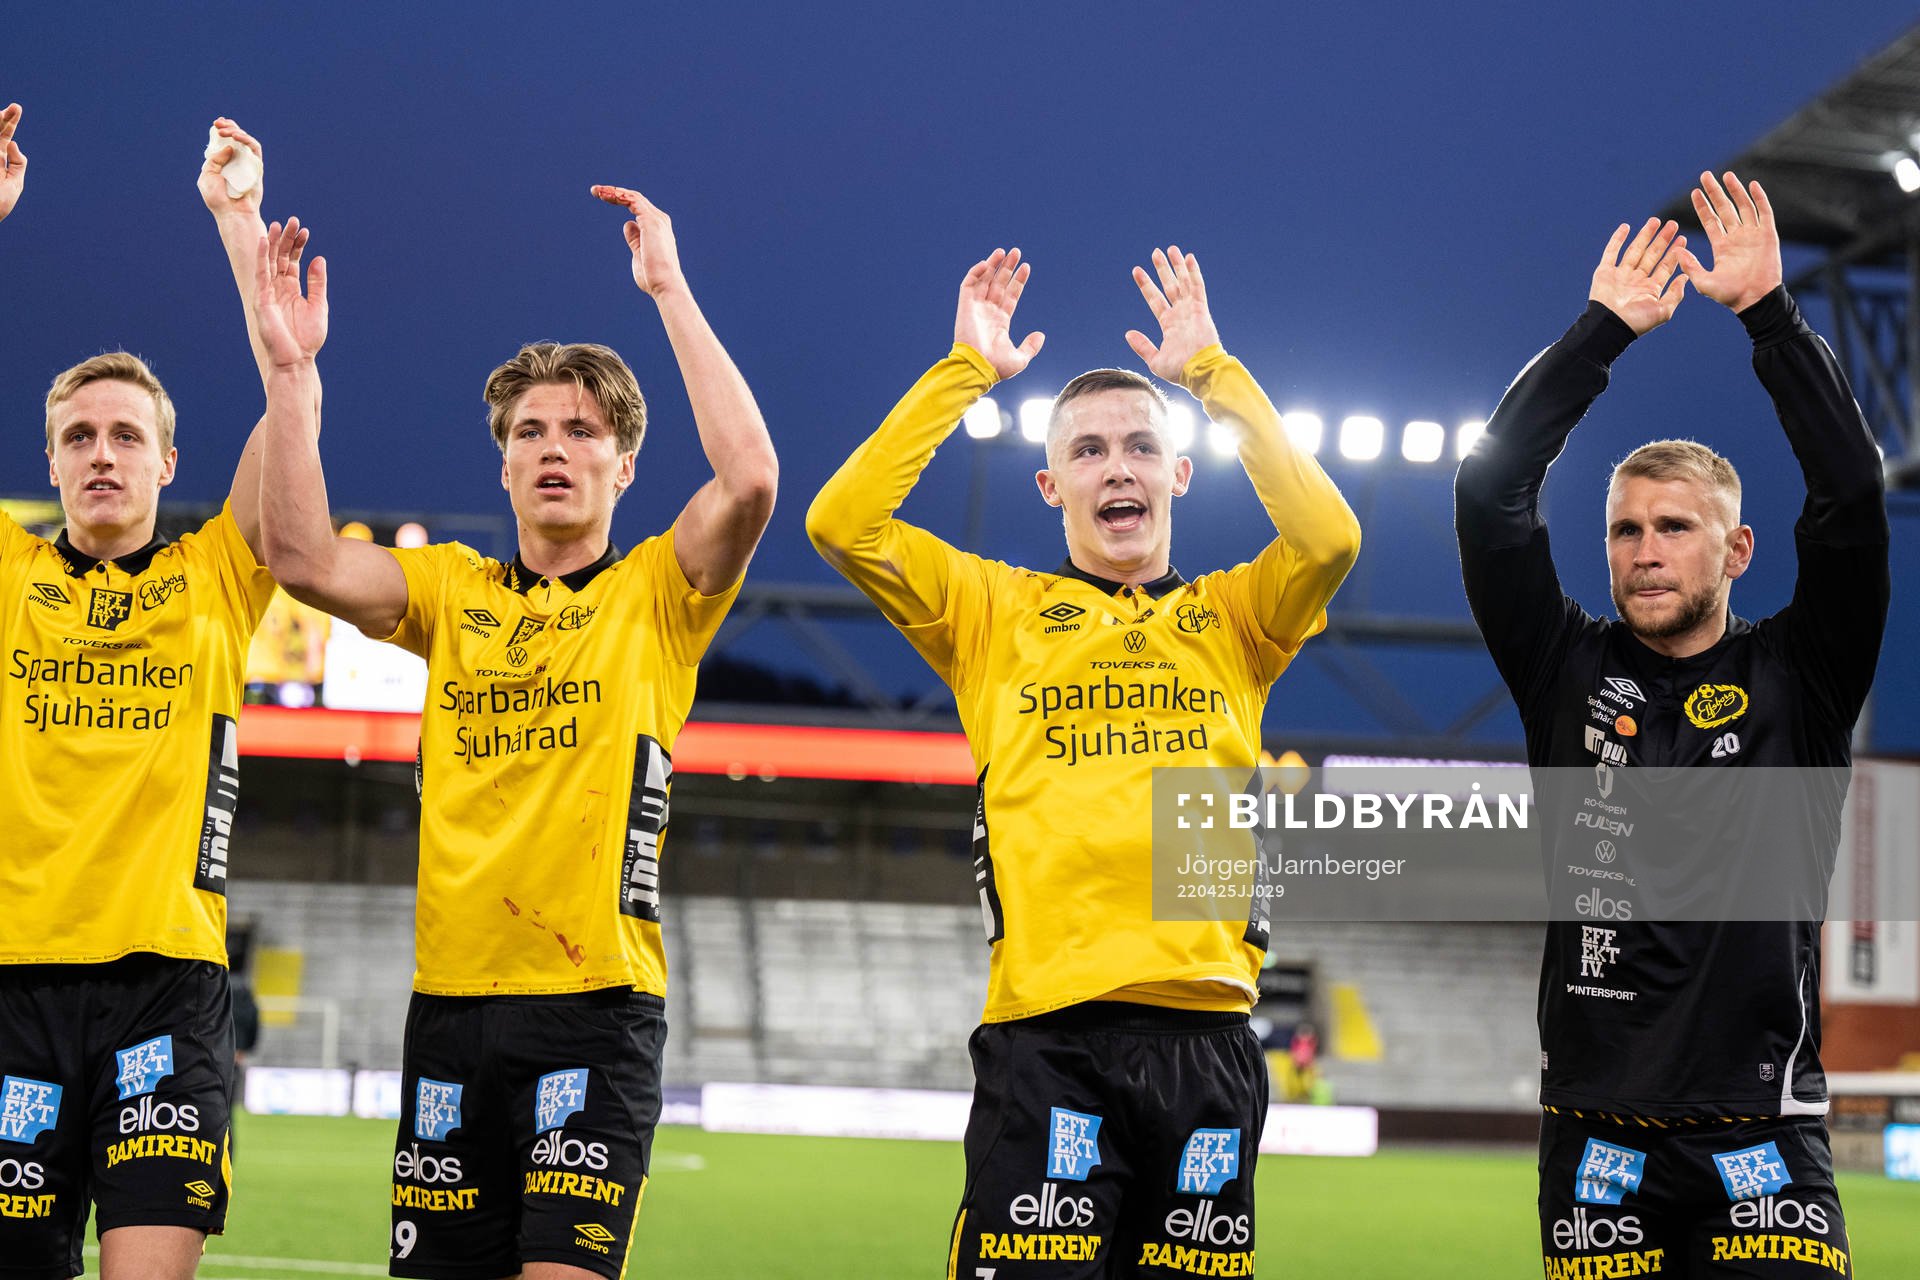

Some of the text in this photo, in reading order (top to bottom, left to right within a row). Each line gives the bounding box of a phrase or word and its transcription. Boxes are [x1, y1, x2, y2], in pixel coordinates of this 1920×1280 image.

[28, 593, 60, 612] umbro
[94, 590, 126, 606] EFF
[139, 574, 187, 611] Elfsborg
[92, 601, 129, 619] EKT
[460, 621, 490, 639] umbro
[1044, 622, 1080, 634] umbro
[63, 637, 123, 649] TOVEKS
[9, 648, 194, 690] Sparbanken
[475, 669, 532, 679] TOVEKS
[1089, 661, 1178, 670] TOVEKS BIL
[439, 676, 602, 720] Sparbanken
[1019, 674, 1228, 719] Sparbanken
[1600, 687, 1634, 710] umbro
[24, 693, 173, 733] Sjuhärad
[454, 716, 578, 765] Sjuhärad
[1045, 721, 1209, 766] Sjuhärad
[1711, 732, 1740, 759] 20
[200, 820, 215, 878] interiör
[621, 843, 637, 901] interiör
[1567, 865, 1625, 881] TOVEKS
[1575, 887, 1633, 921] ellos
[1581, 925, 1617, 947] EFF
[1581, 942, 1620, 965] EKT
[1574, 985, 1636, 1001] INTERSPORT
[122, 1039, 162, 1067] EFF
[121, 1055, 168, 1081] EKT
[6, 1080, 53, 1105] EFF
[419, 1081, 453, 1104] EFF
[539, 1072, 579, 1096] EFF
[2, 1098, 55, 1124] EKT
[418, 1100, 456, 1123] EKT
[539, 1089, 581, 1112] EKT
[119, 1095, 200, 1135] ellos
[1055, 1112, 1090, 1136] EFF
[107, 1134, 217, 1169] RAMIRENT
[531, 1130, 610, 1170] ellos
[1054, 1133, 1094, 1159] EKT
[1189, 1133, 1231, 1154] EFF
[394, 1142, 464, 1183] ellos
[1183, 1152, 1235, 1174] EKT
[1587, 1143, 1635, 1172] EFF
[1719, 1148, 1767, 1174] EFF
[524, 1170, 625, 1207] RAMIRENT
[1726, 1161, 1782, 1192] EKT
[187, 1196, 211, 1210] umbro
[1009, 1182, 1095, 1229] ellos
[1729, 1196, 1830, 1235] ellos
[1164, 1199, 1249, 1245] ellos
[1552, 1207, 1645, 1251] ellos
[390, 1220, 418, 1259] 9
[575, 1236, 610, 1255] umbro
[979, 1233, 1101, 1262] RAMIRENT
[1137, 1242, 1256, 1278] RAMIREN
[1545, 1248, 1665, 1280] RAMIRENT
[1711, 1235, 1848, 1276] RAMIRENT
